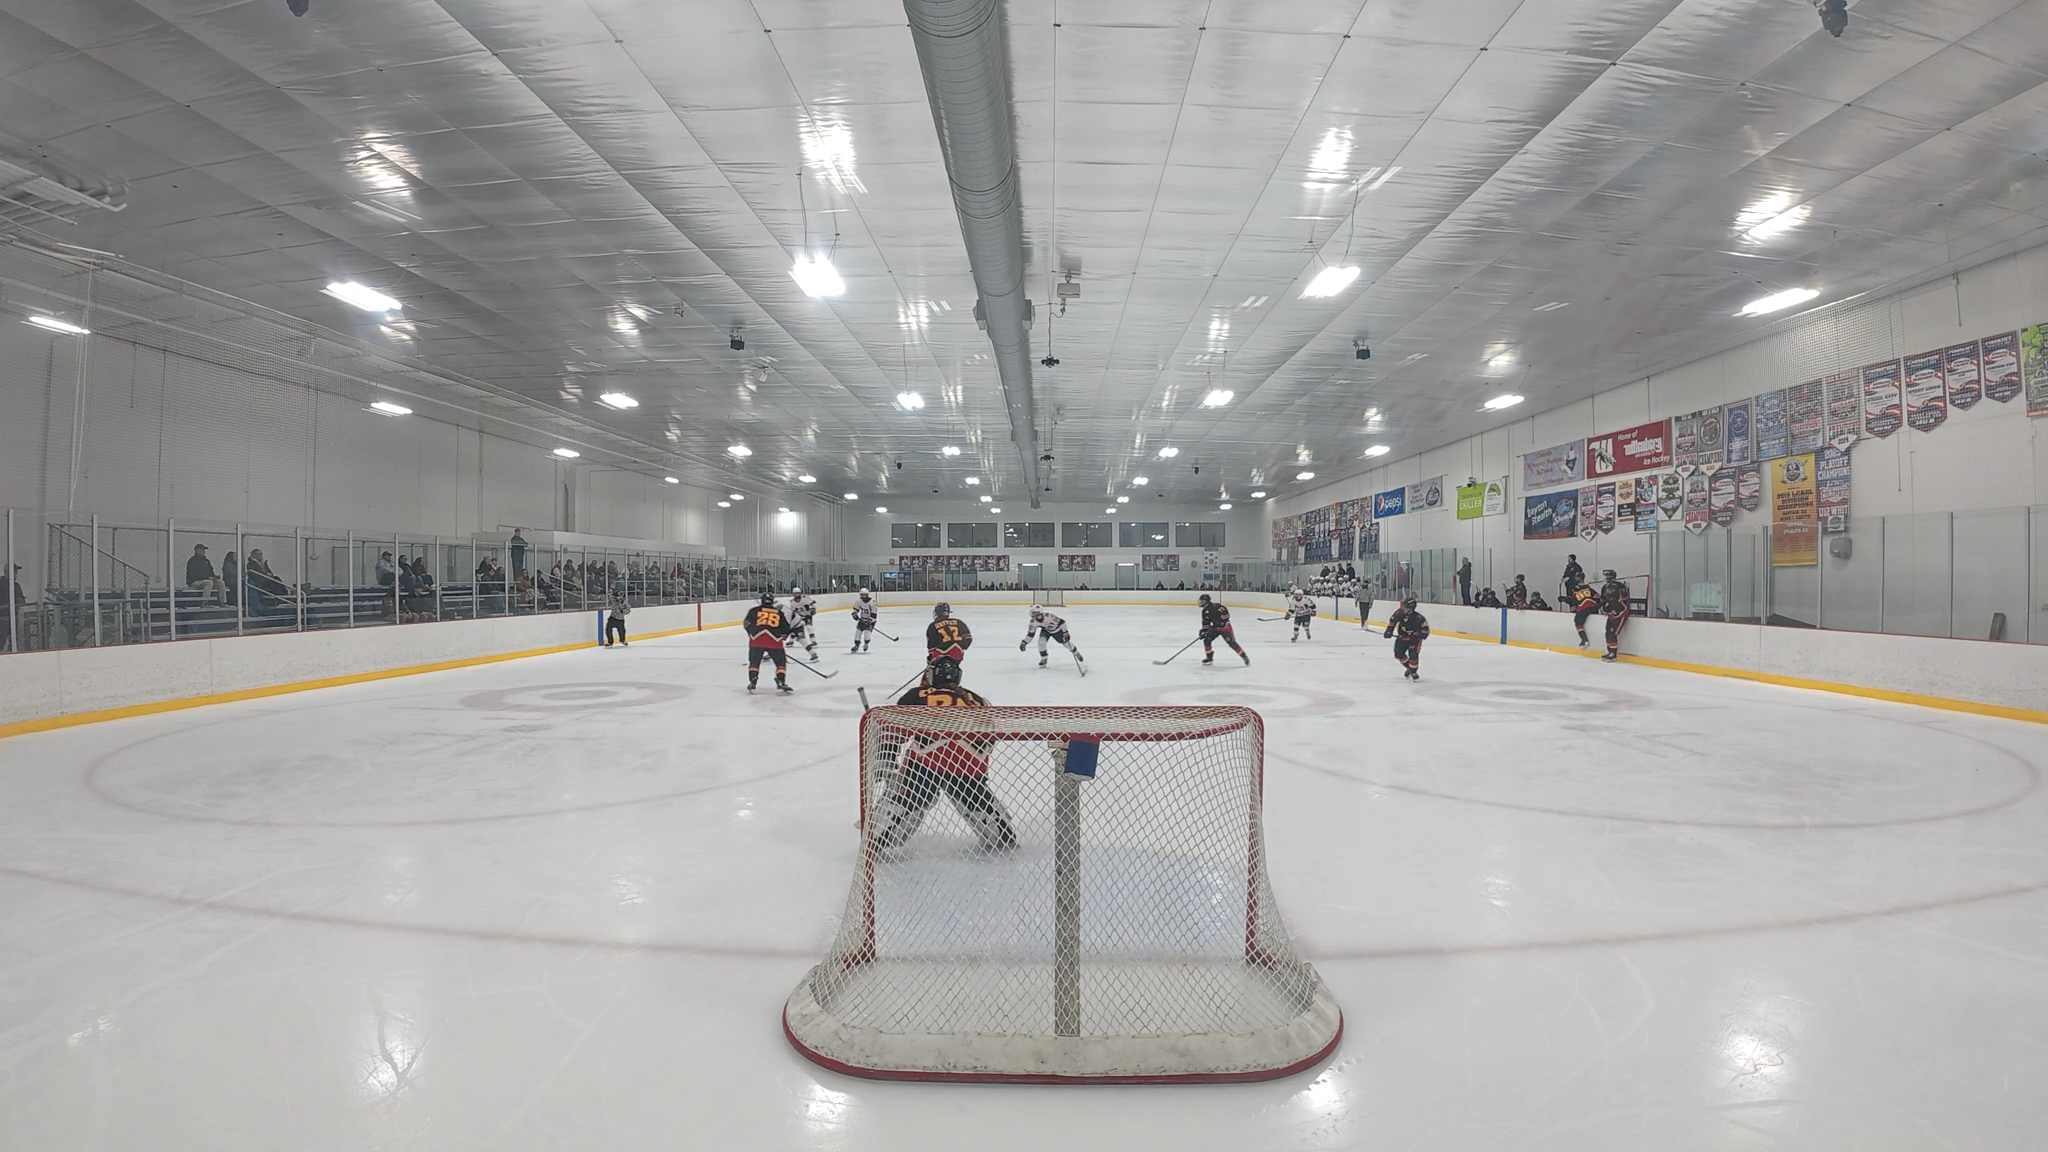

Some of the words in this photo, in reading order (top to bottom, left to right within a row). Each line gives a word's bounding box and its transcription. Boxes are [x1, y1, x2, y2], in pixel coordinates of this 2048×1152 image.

[1618, 433, 1631, 441] Home
[1632, 430, 1638, 438] of
[1651, 455, 1671, 463] Hockey
[1820, 456, 1849, 470] PLAYOFF
[1818, 466, 1851, 480] CHAMPIONS
[1384, 494, 1402, 511] pepsi
[1459, 499, 1482, 510] CHILLER
